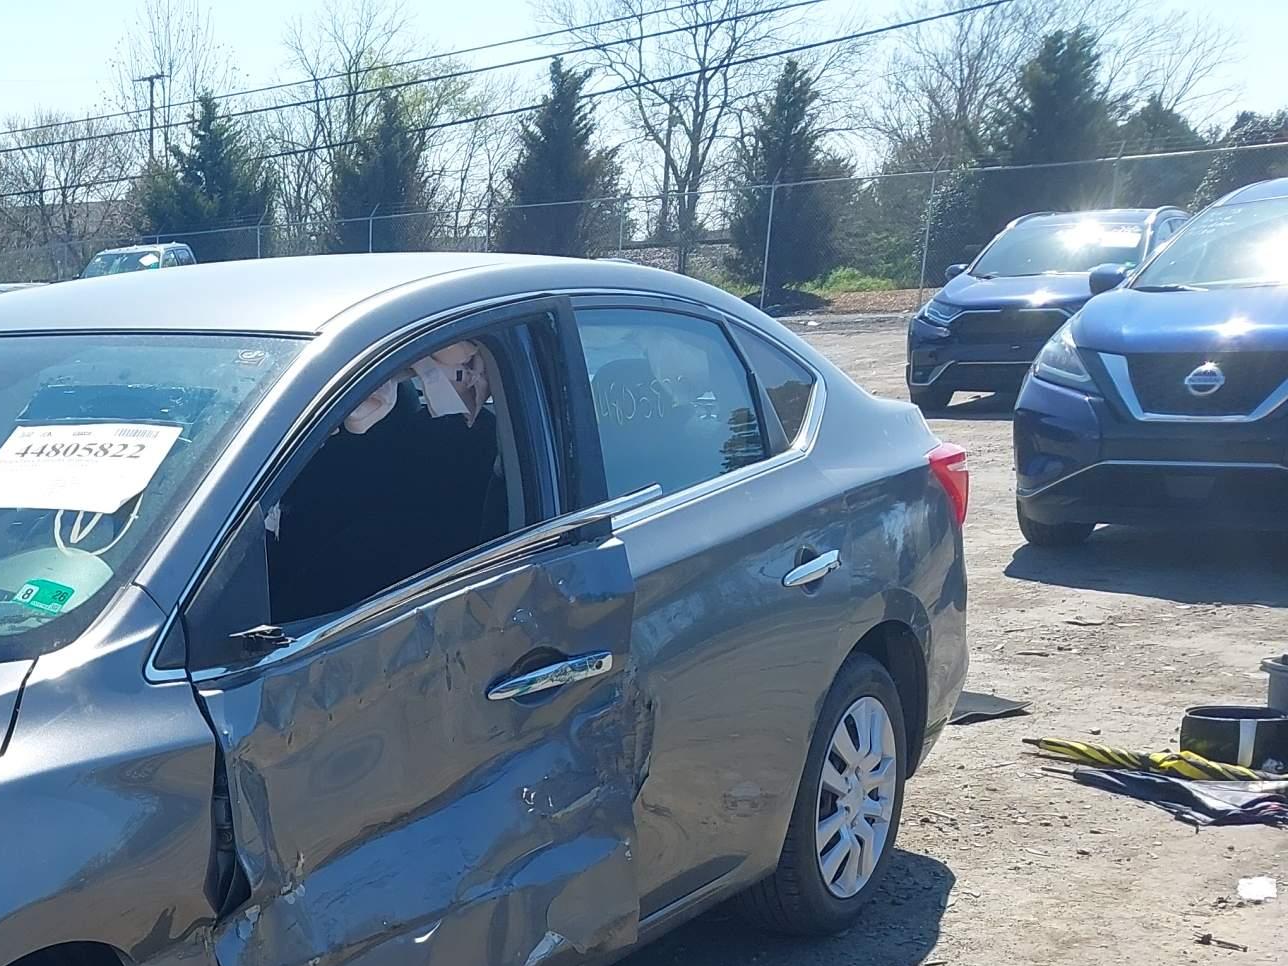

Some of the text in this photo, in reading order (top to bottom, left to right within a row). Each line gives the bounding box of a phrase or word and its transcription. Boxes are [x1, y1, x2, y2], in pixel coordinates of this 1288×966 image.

[15, 442, 146, 459] 44805822
[22, 588, 34, 600] 8
[52, 590, 69, 603] 26
